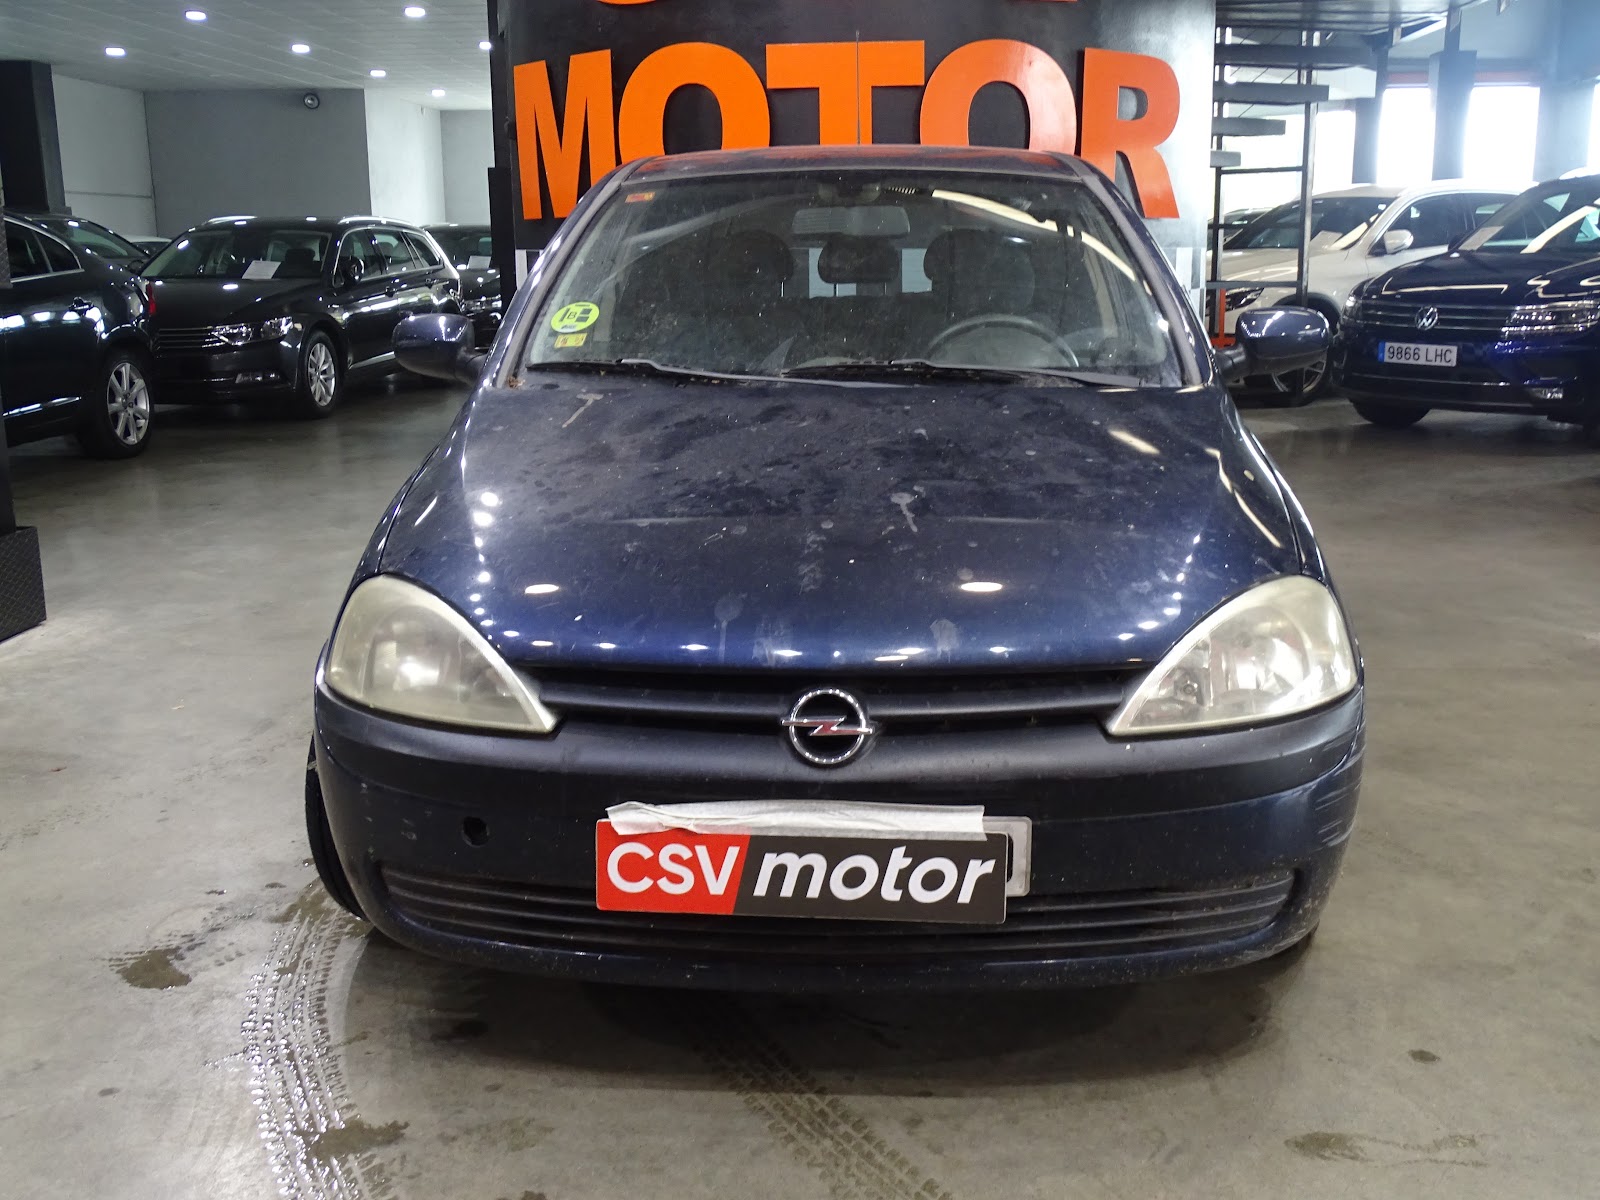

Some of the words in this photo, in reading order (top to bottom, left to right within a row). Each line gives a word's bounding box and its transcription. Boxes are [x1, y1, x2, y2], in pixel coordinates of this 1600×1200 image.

[513, 40, 1180, 219] MOTOR
[1387, 345, 1420, 361] 9866
[1425, 348, 1453, 363] LHC
[606, 842, 741, 896] CSV
[753, 845, 996, 904] motor
